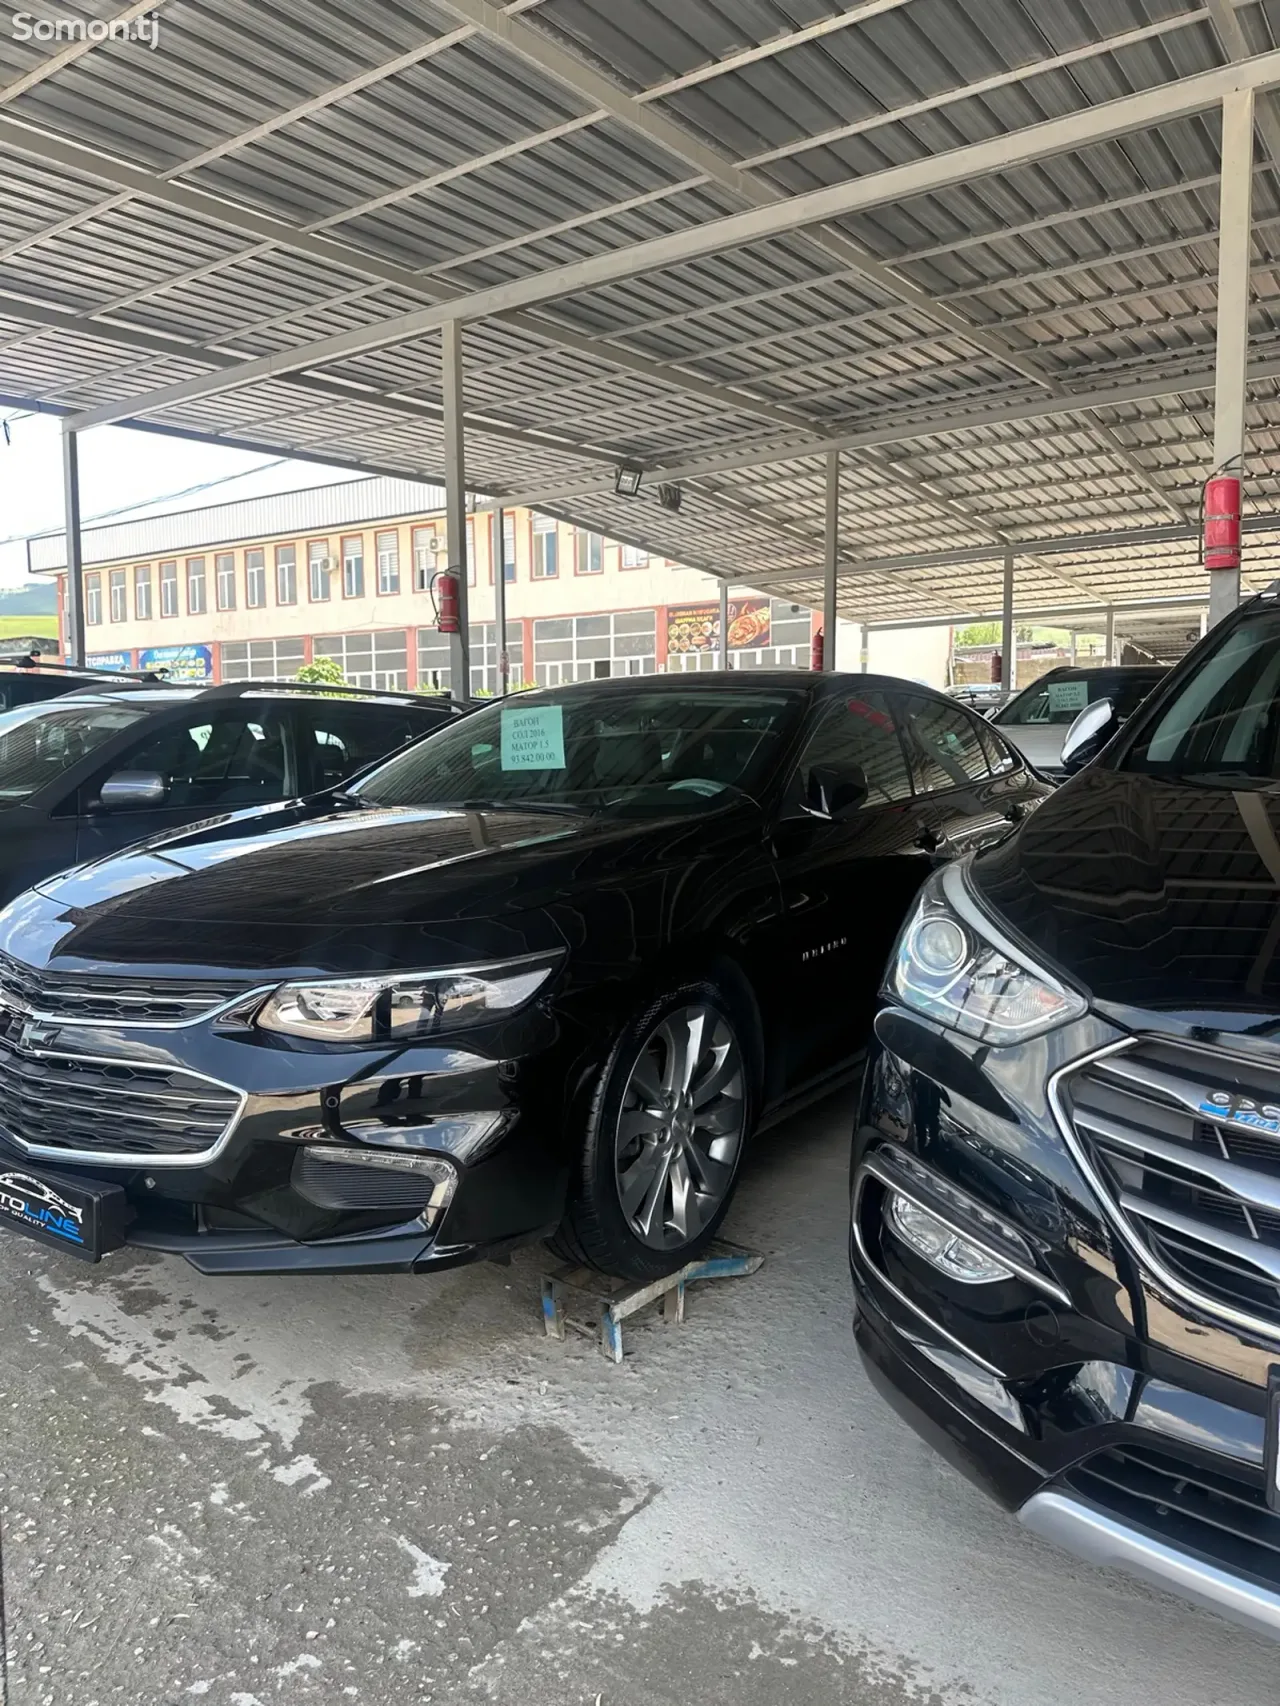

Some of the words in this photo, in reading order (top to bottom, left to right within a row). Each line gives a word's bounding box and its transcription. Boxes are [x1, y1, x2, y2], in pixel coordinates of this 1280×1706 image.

[513, 717, 540, 728] ВАГОН
[530, 728, 546, 738] 2016
[511, 741, 538, 751] МАТОР
[11, 1209, 46, 1228] QUALITY
